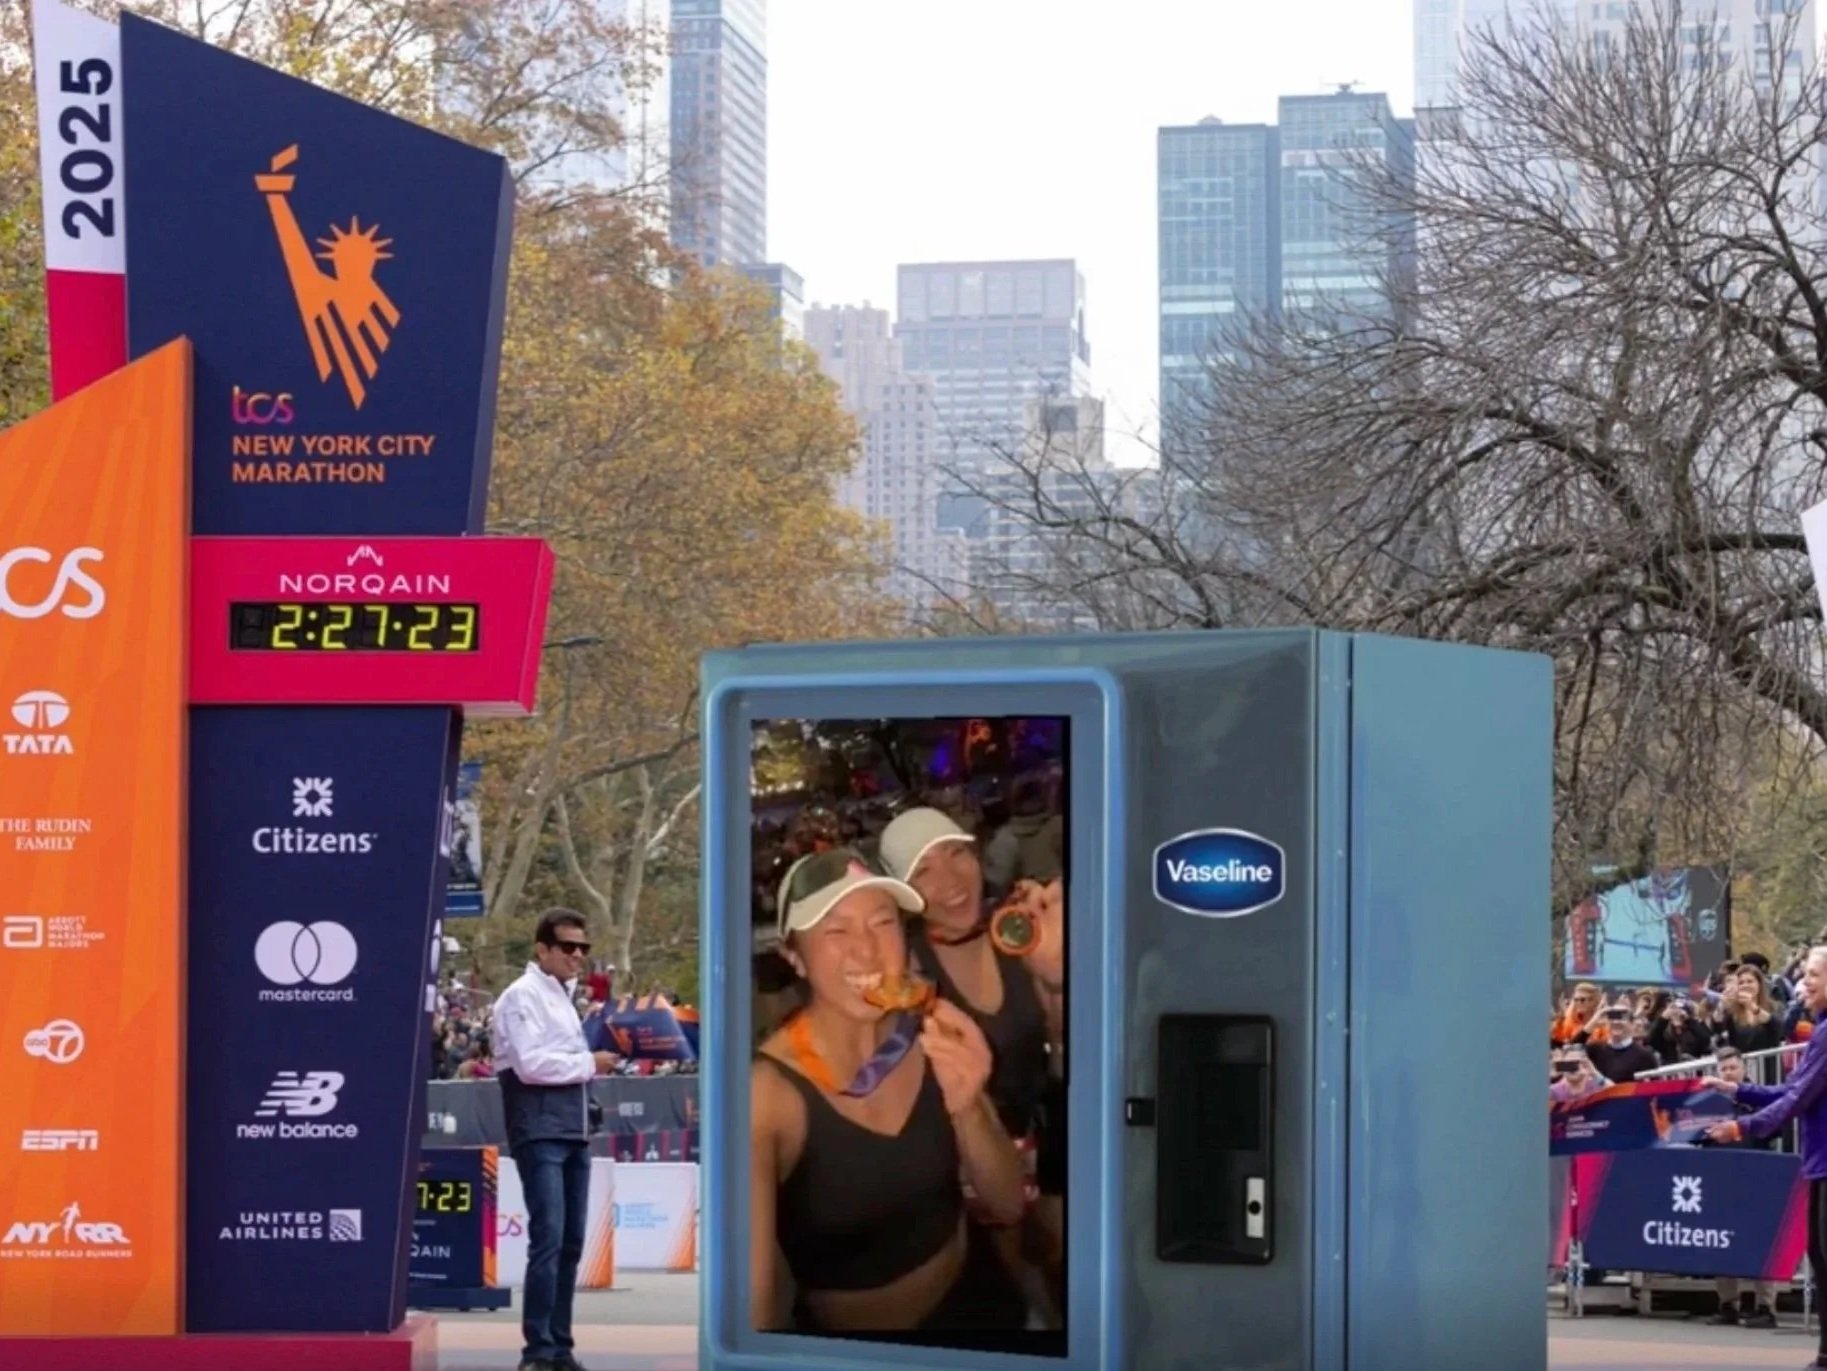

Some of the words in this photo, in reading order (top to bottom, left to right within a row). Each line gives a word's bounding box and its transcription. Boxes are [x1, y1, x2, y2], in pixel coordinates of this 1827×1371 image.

[58, 57, 115, 240] 2025
[232, 385, 295, 425] tcs
[232, 435, 294, 456] NEW
[301, 435, 371, 456] YORK
[377, 435, 436, 456] CITY
[232, 462, 385, 483] MARATHON
[279, 574, 451, 594] NORQAIN
[3, 734, 74, 754] TATA
[0, 818, 31, 832] THE
[35, 818, 92, 832] RUDIN
[15, 836, 76, 851] FAMILY
[252, 827, 373, 854] Citizens
[1166, 858, 1273, 882] Vaseline
[258, 987, 354, 1001] mastercard
[236, 1123, 275, 1139] new
[279, 1121, 359, 1139] balance
[21, 1130, 98, 1151] ESPN
[240, 1212, 323, 1225] UNITED
[219, 1226, 323, 1240] AIRLINES
[1643, 1220, 1731, 1249] Citizens
